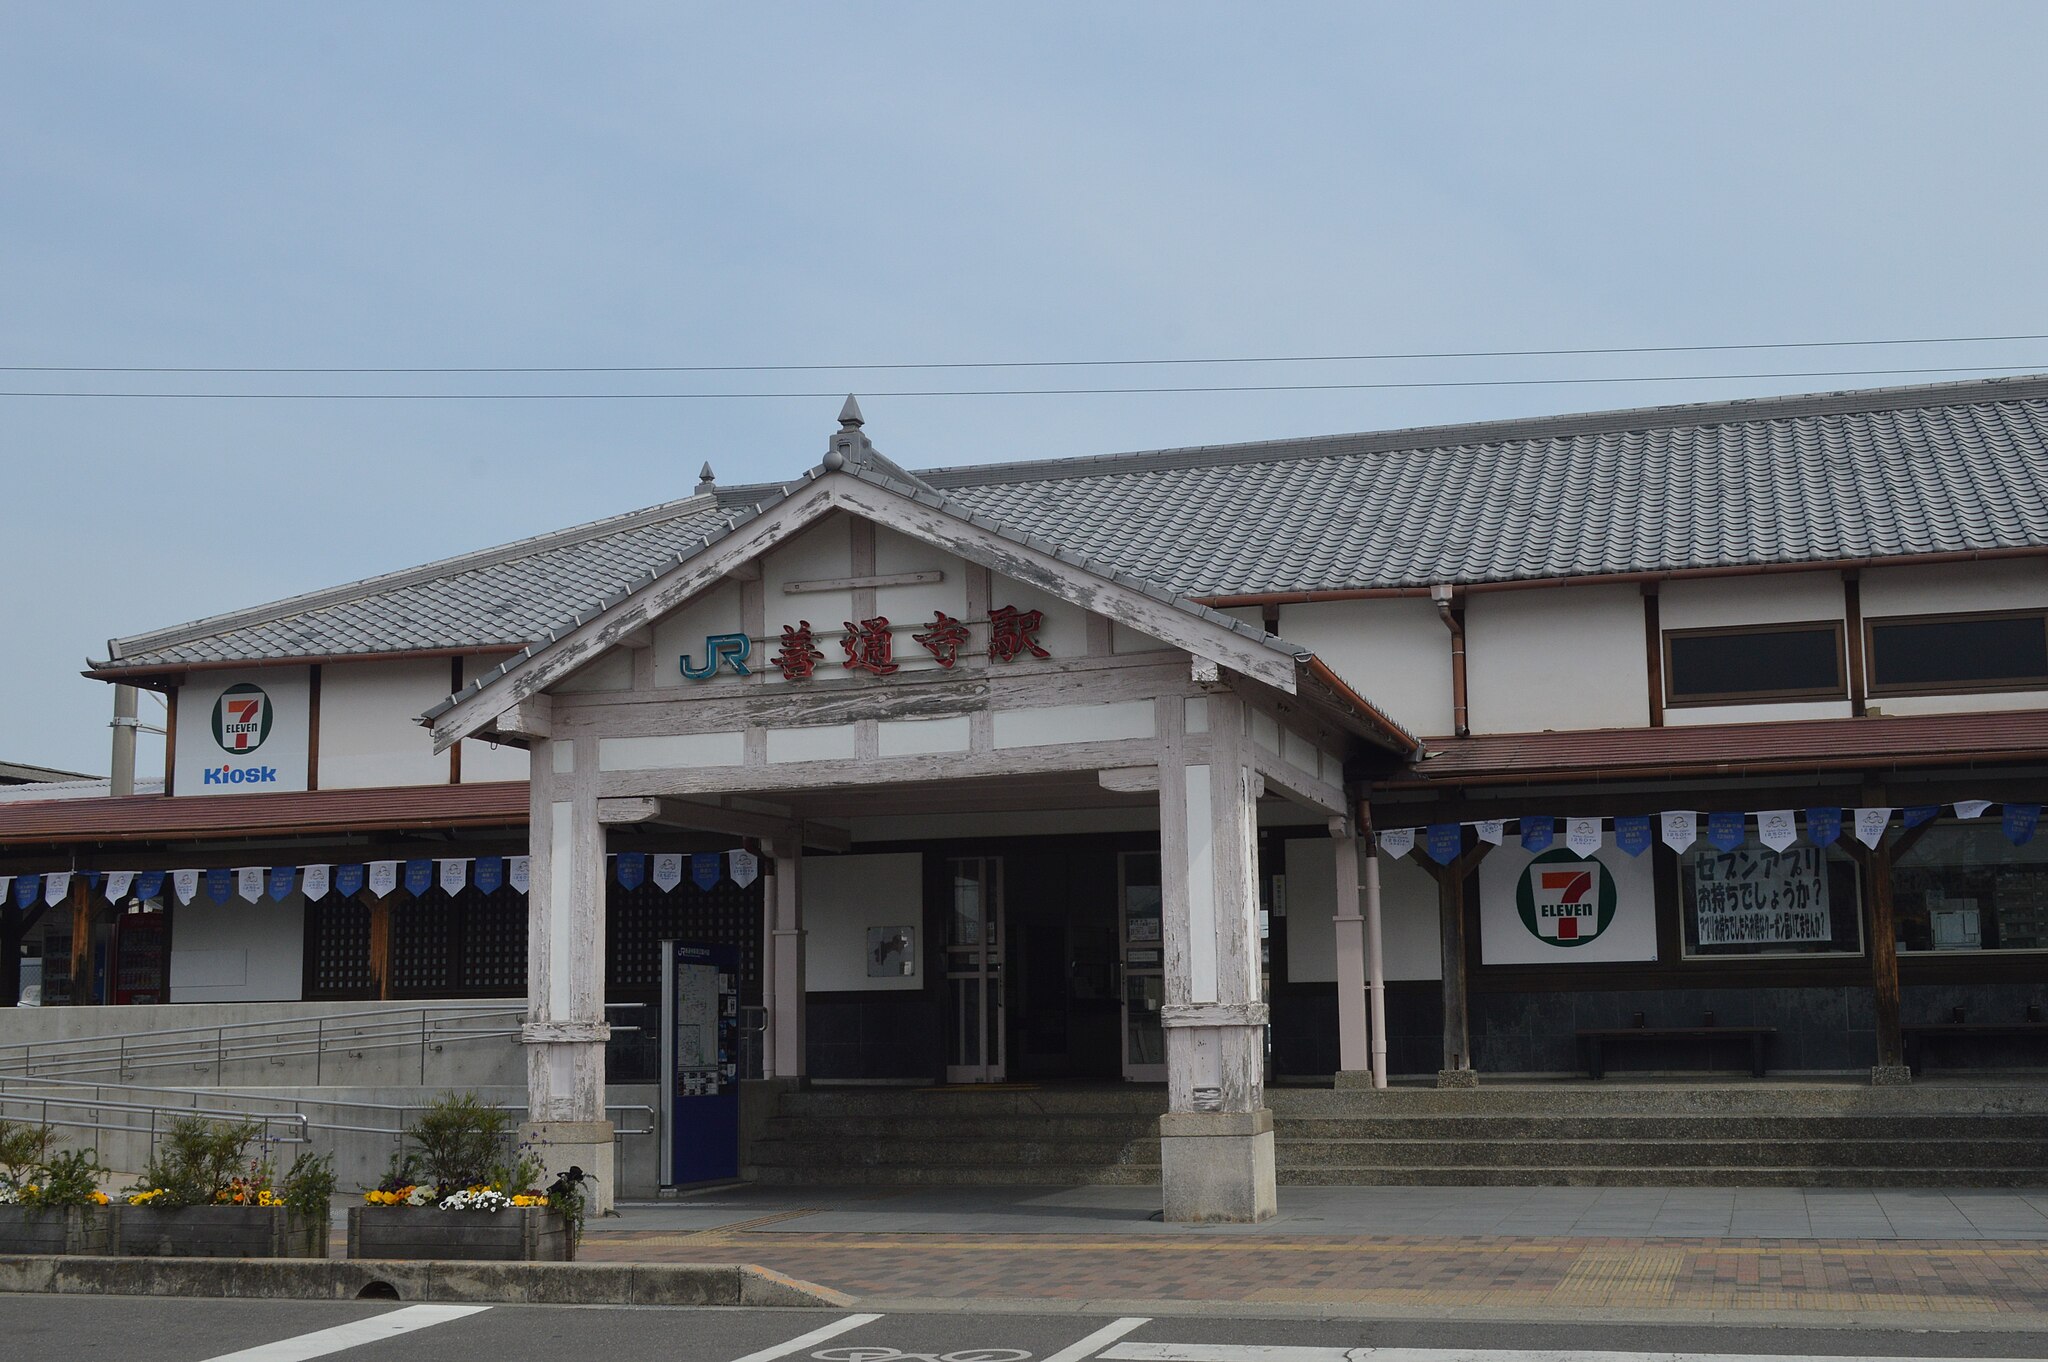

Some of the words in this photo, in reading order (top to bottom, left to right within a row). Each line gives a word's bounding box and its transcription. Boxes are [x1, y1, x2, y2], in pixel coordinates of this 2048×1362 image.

[679, 632, 753, 680] JR
[770, 604, 1051, 680] 善通寺駅
[204, 764, 277, 784] Kiosk
[1696, 848, 1820, 880] セブンアプリ
